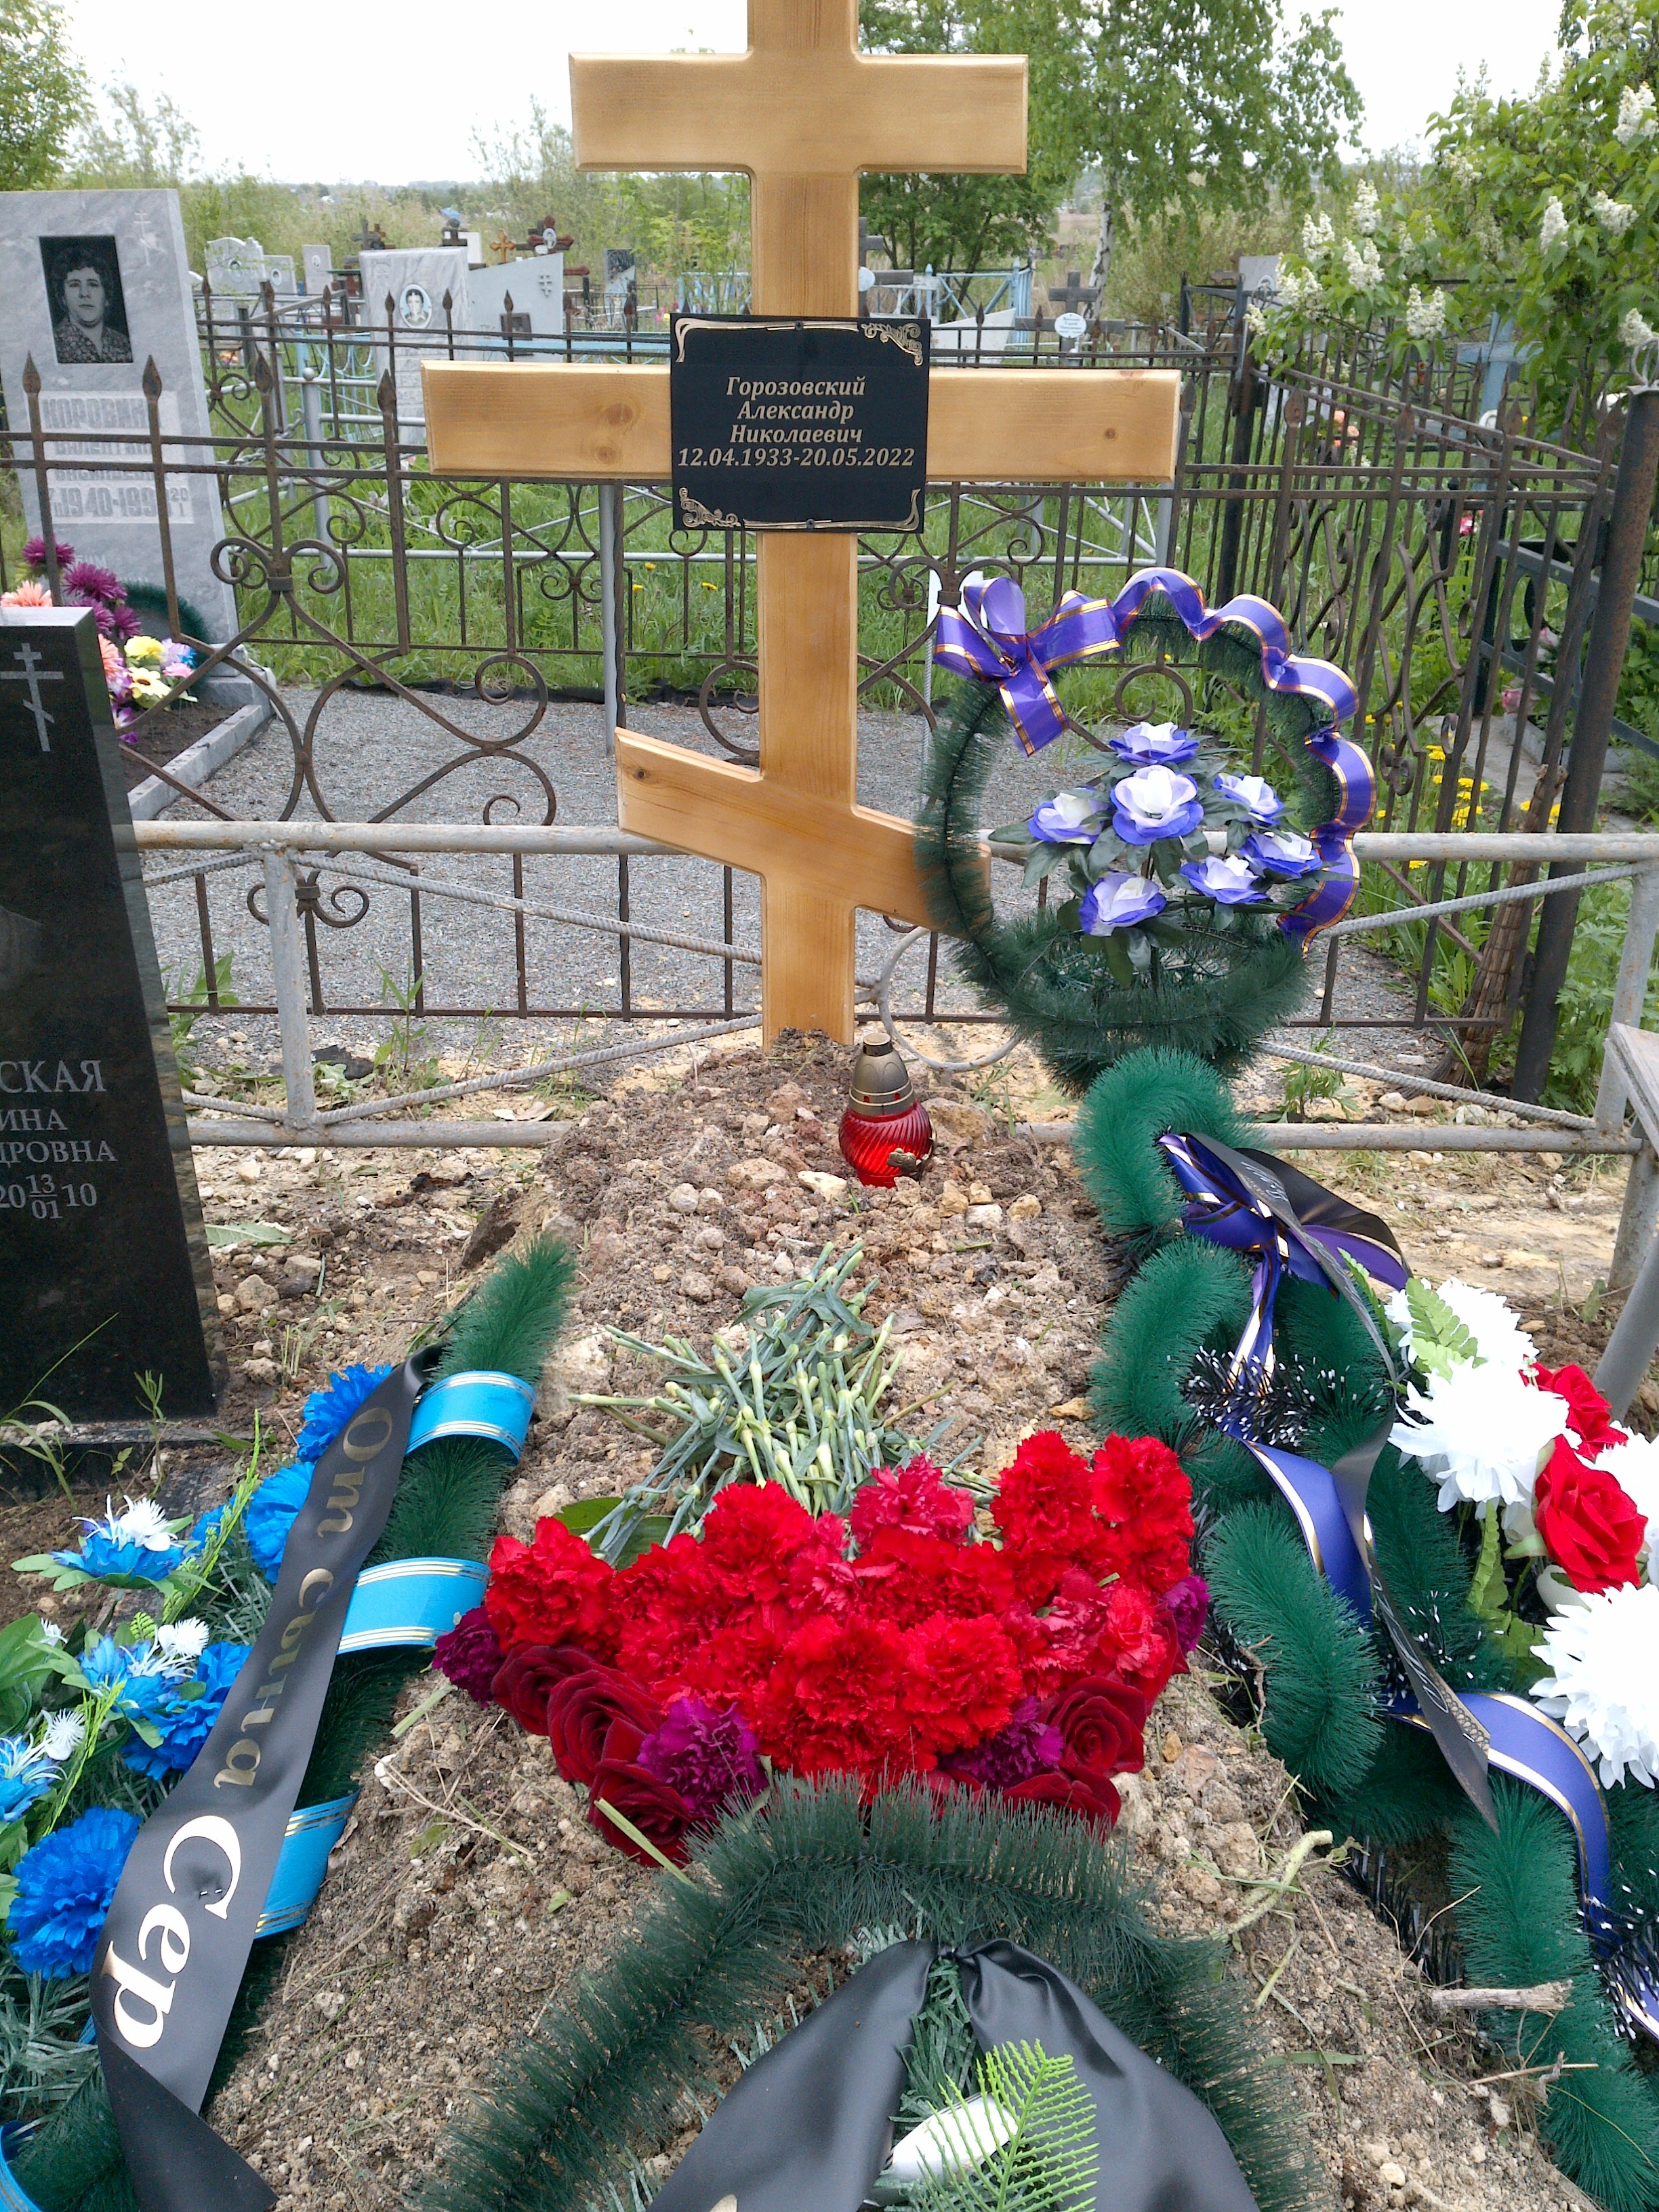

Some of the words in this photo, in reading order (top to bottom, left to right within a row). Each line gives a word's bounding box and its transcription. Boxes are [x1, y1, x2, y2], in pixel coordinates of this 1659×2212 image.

[726, 376, 866, 401] Горозовский
[41, 398, 150, 429] КОРОВИН
[737, 401, 855, 424] Александр
[729, 425, 863, 443] Николаевич
[678, 447, 915, 466] 12.04.1933-20.05.2022
[213, 1568, 334, 1789] сына
[101, 1815, 241, 2049] Сер
